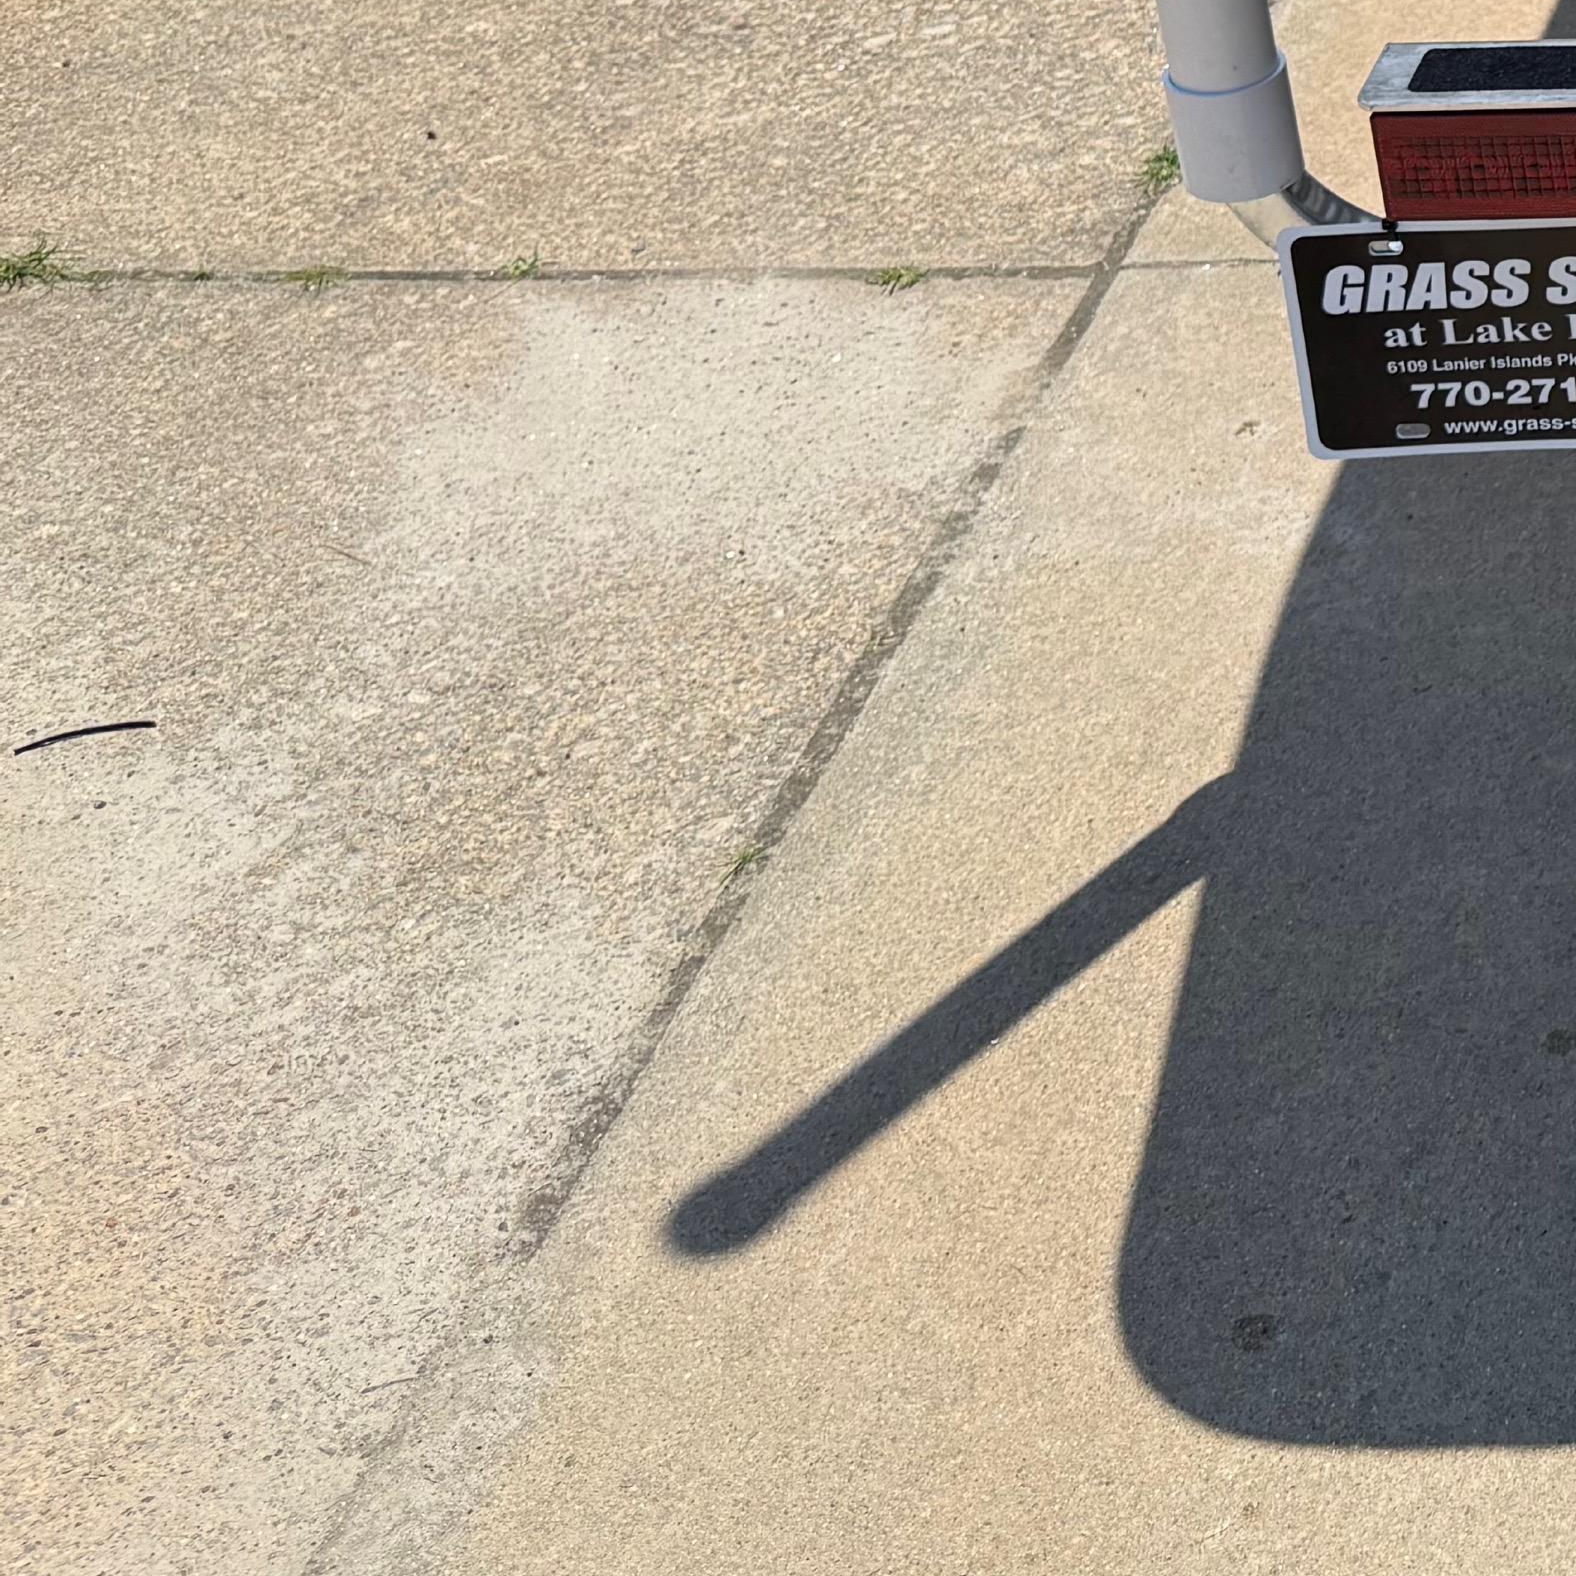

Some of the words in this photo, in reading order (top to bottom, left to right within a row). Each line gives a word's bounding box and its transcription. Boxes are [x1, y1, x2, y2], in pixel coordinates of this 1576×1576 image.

[1322, 258, 1532, 315] GRASS
[1384, 321, 1428, 348] at
[1438, 316, 1553, 346] Lake
[1387, 359, 1428, 374] 6109
[1433, 356, 1486, 372] Lanier
[1491, 354, 1553, 369] Islands
